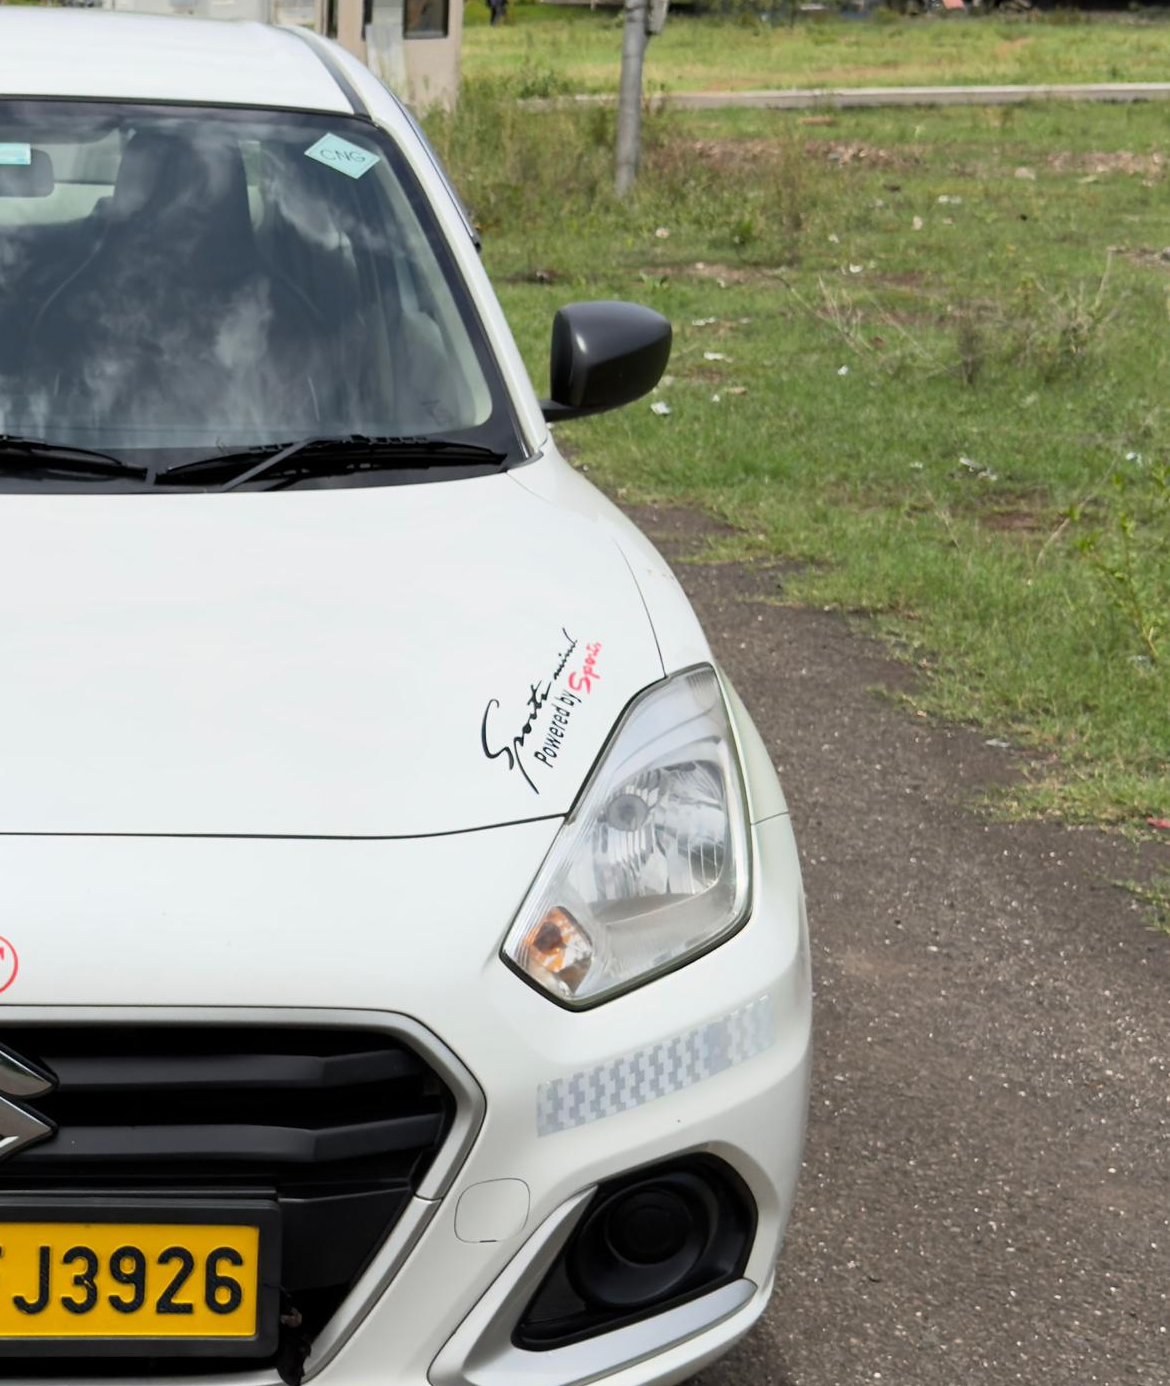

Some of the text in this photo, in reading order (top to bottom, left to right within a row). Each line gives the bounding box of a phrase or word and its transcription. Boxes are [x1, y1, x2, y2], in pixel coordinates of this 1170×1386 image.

[320, 148, 366, 163] CNG
[533, 704, 571, 769] Powered
[554, 688, 582, 707] by
